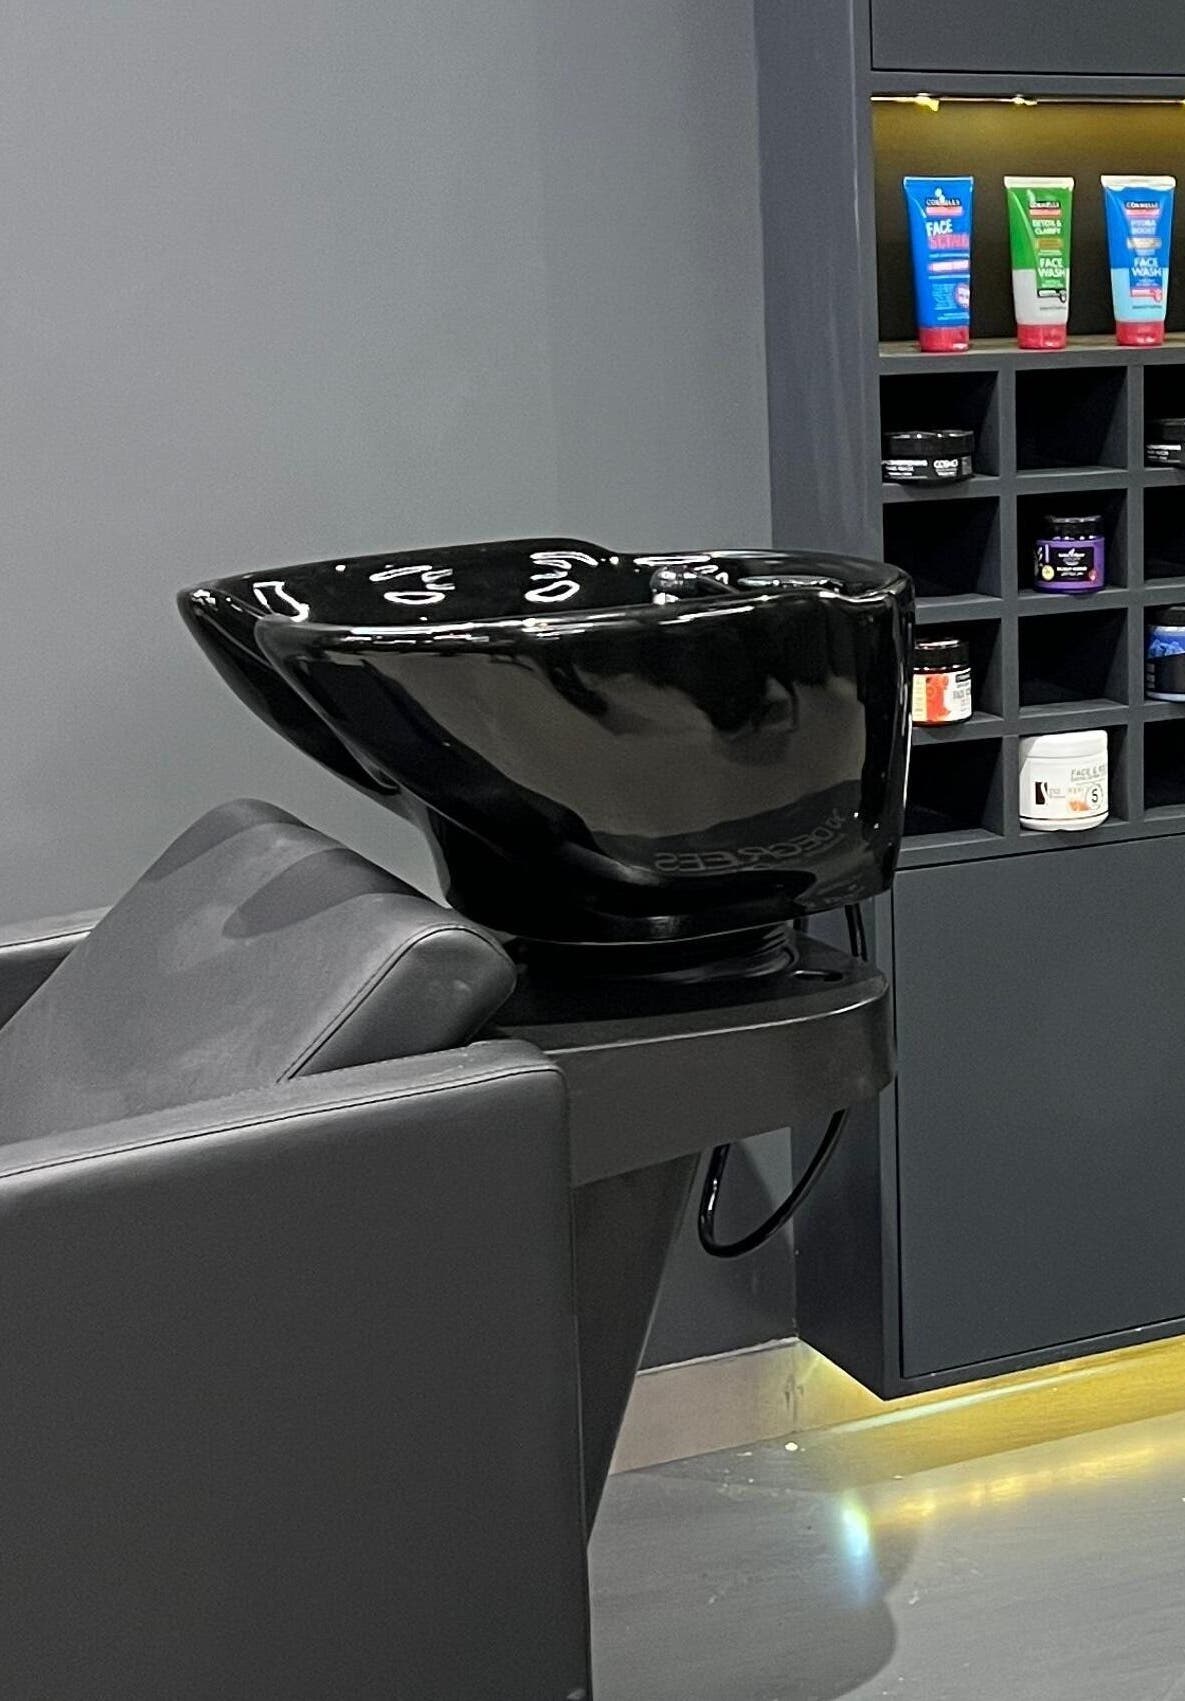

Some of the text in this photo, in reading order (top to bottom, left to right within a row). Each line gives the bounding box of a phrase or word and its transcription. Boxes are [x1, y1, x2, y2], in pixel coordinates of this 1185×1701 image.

[926, 219, 953, 236] FACE
[1039, 257, 1063, 268] FACE
[1133, 257, 1159, 267] FACE
[1038, 268, 1066, 278] WASH
[1130, 267, 1162, 277] WASH
